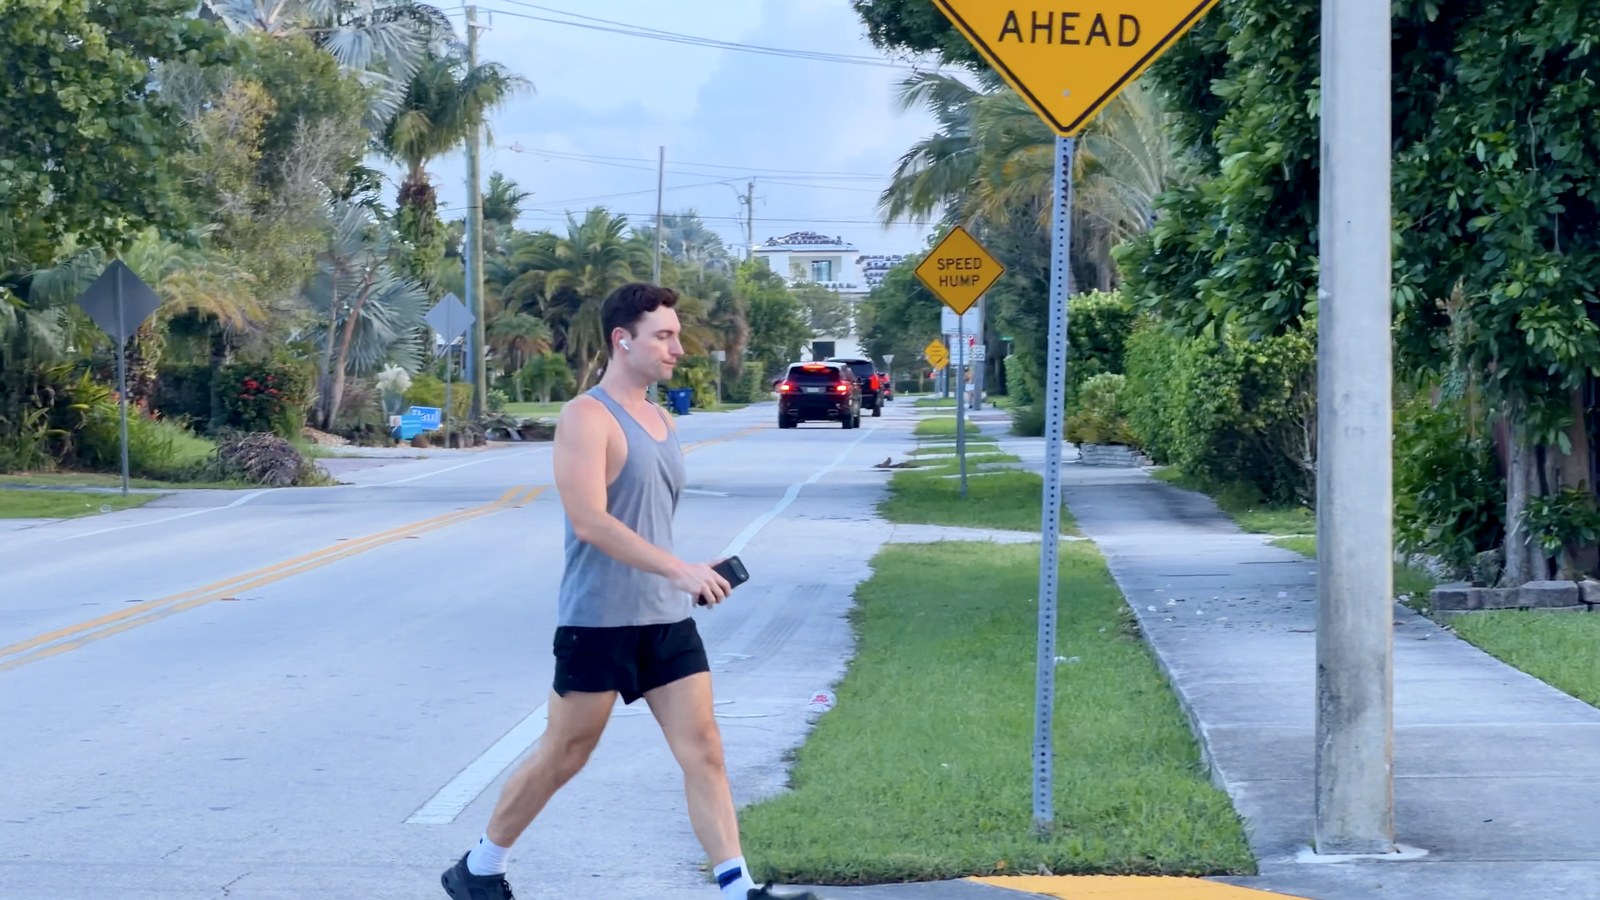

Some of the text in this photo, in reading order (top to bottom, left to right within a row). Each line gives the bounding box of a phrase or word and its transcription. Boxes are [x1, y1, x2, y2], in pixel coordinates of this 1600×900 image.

[998, 10, 1140, 47] AHEAD
[937, 257, 982, 270] SPEED
[939, 274, 980, 287] HUMP
